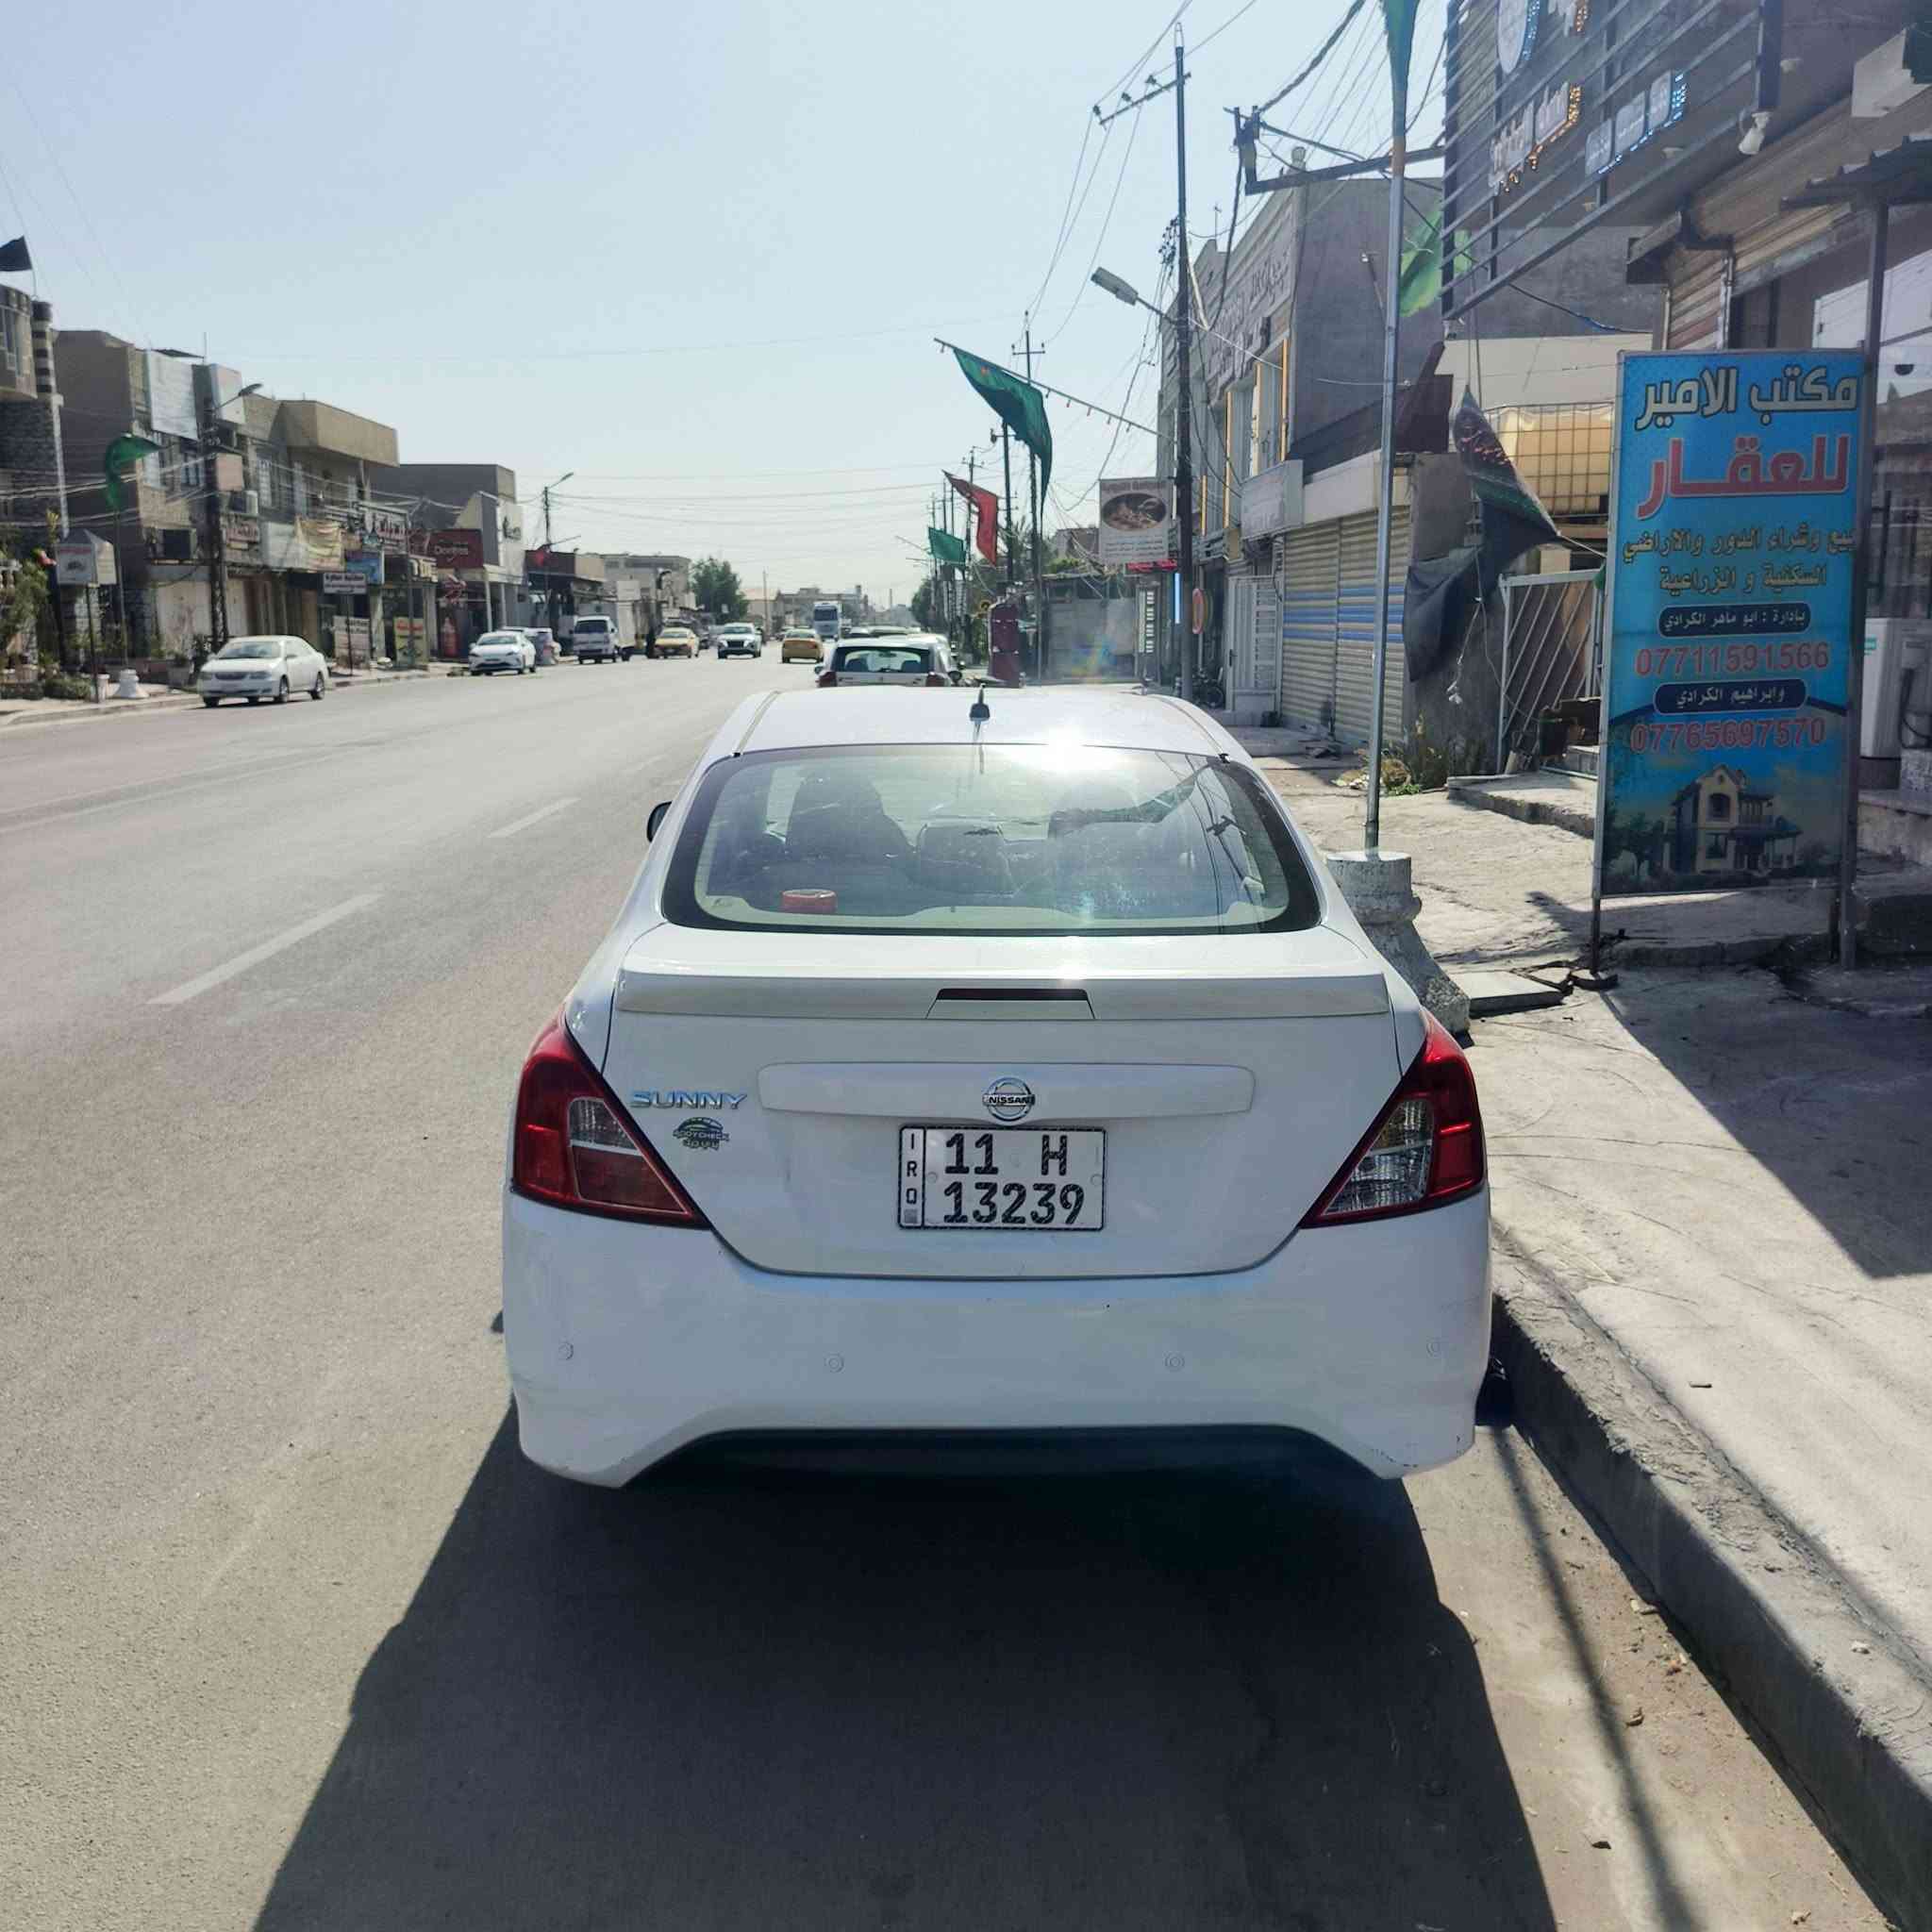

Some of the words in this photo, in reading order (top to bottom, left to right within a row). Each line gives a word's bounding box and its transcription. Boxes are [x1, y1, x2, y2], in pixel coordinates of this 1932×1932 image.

[1635, 366, 1740, 431] الامير
[1750, 364, 1858, 425] مكتب
[1711, 526, 1762, 556] الدور
[1659, 566, 1737, 596] الزراعية
[1635, 641, 1830, 675] 07711591566
[629, 1090, 748, 1110] SUNNY
[989, 1094, 1030, 1105] NISSAN
[944, 1132, 999, 1175] 11
[1041, 1134, 1068, 1176] H
[943, 1180, 1085, 1225] 13239
